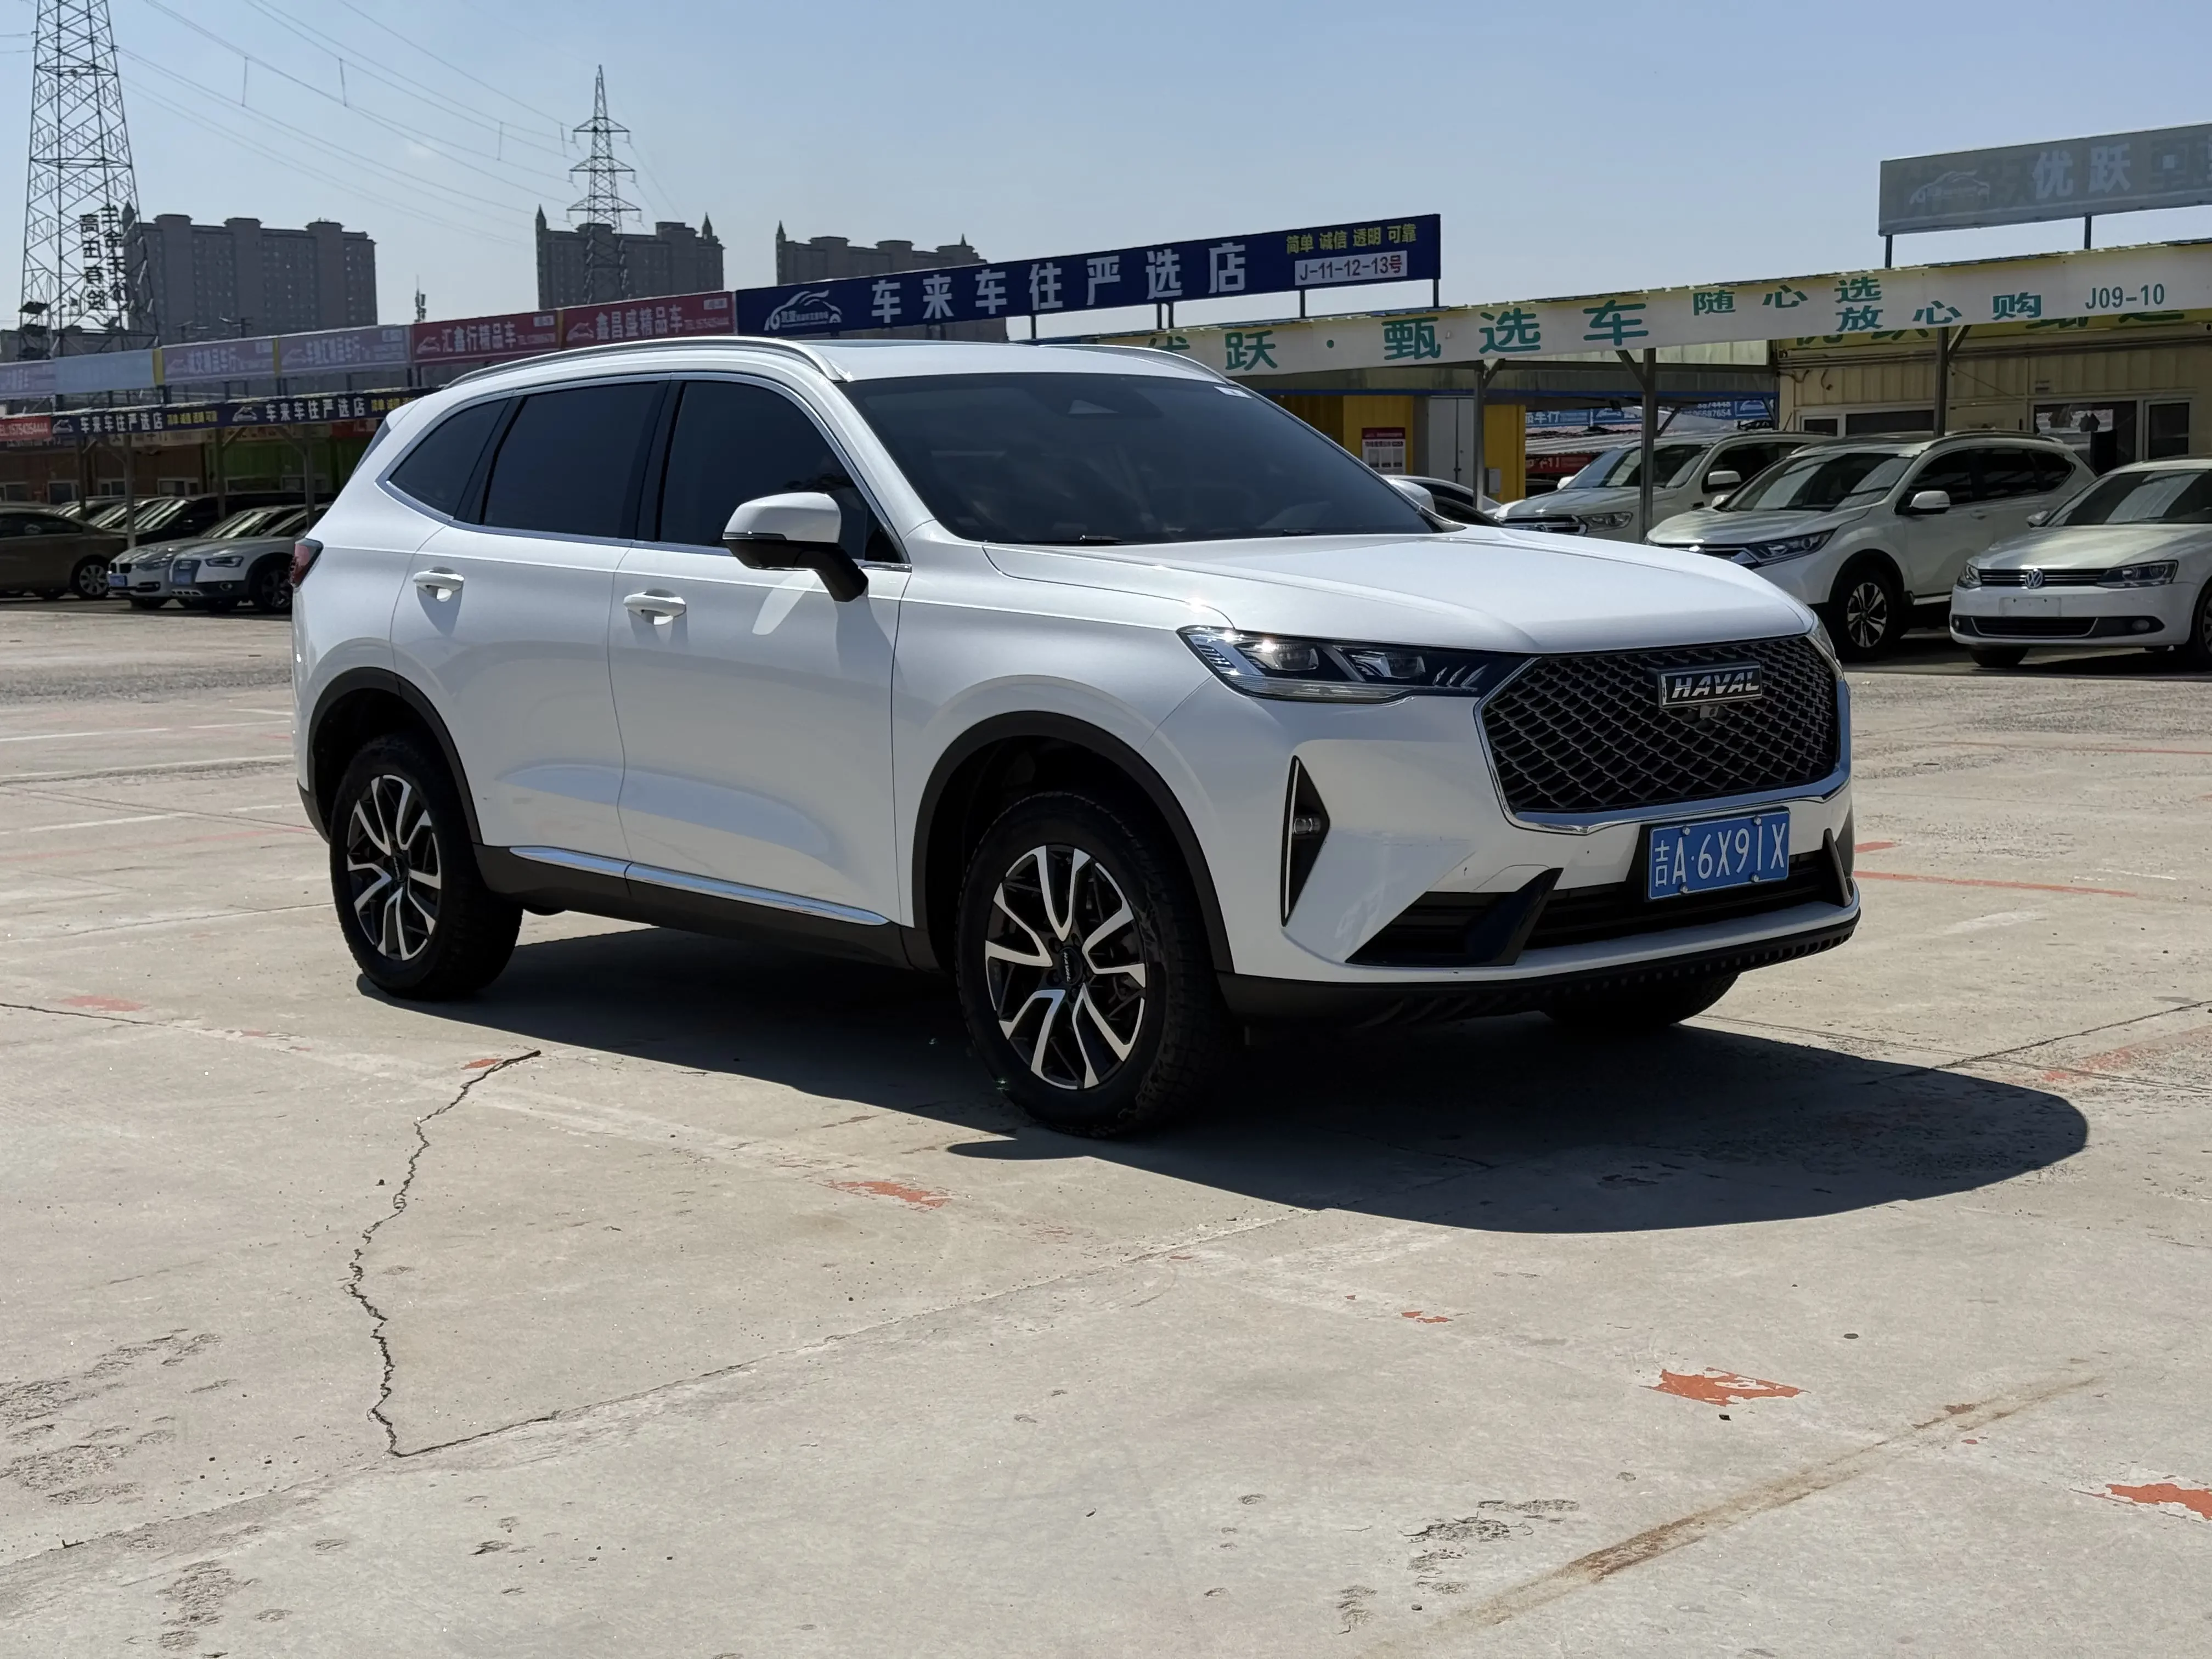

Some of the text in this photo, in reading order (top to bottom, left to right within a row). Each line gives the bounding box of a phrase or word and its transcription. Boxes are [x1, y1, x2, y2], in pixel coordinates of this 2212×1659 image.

[1286, 223, 1416, 254] 简单 诚信 透明 可靠
[871, 242, 1245, 323] 车来车往严选店
[1300, 255, 1402, 280] J-11-12-13号
[1692, 276, 1882, 315] 随心选
[2085, 284, 2165, 309] J09-10
[1835, 292, 2041, 332] 放心购
[1672, 671, 1759, 698] HAVAL
